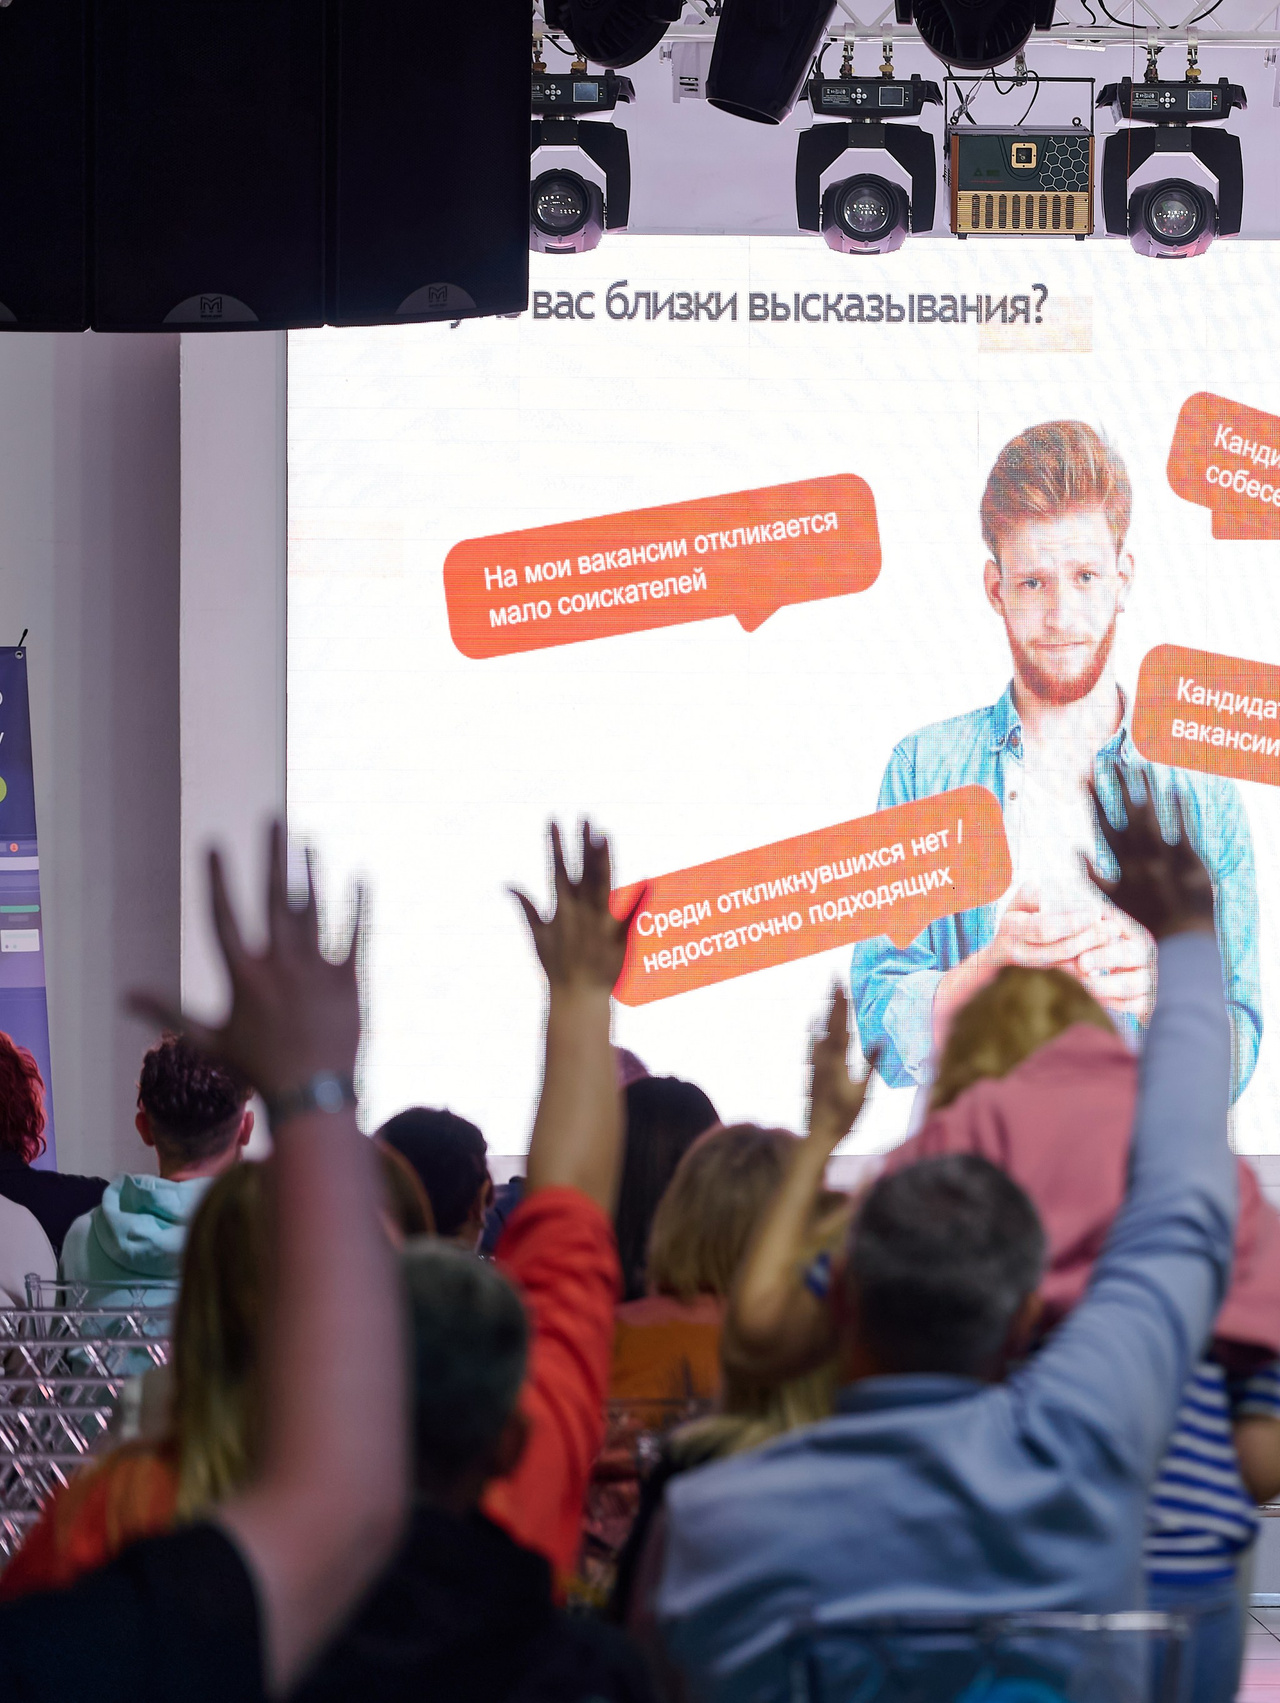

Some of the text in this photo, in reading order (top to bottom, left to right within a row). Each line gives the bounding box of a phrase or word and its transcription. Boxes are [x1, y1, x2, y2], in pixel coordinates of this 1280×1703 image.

[532, 279, 1048, 324] вас близки высказывания?
[484, 510, 839, 591] На мои вакансии откликается
[489, 567, 708, 628] мало соискателей
[1171, 718, 1280, 758] вакансии
[636, 819, 964, 938] Среди откликнувшихся нет /
[643, 866, 954, 974] недостаточно подходящих
